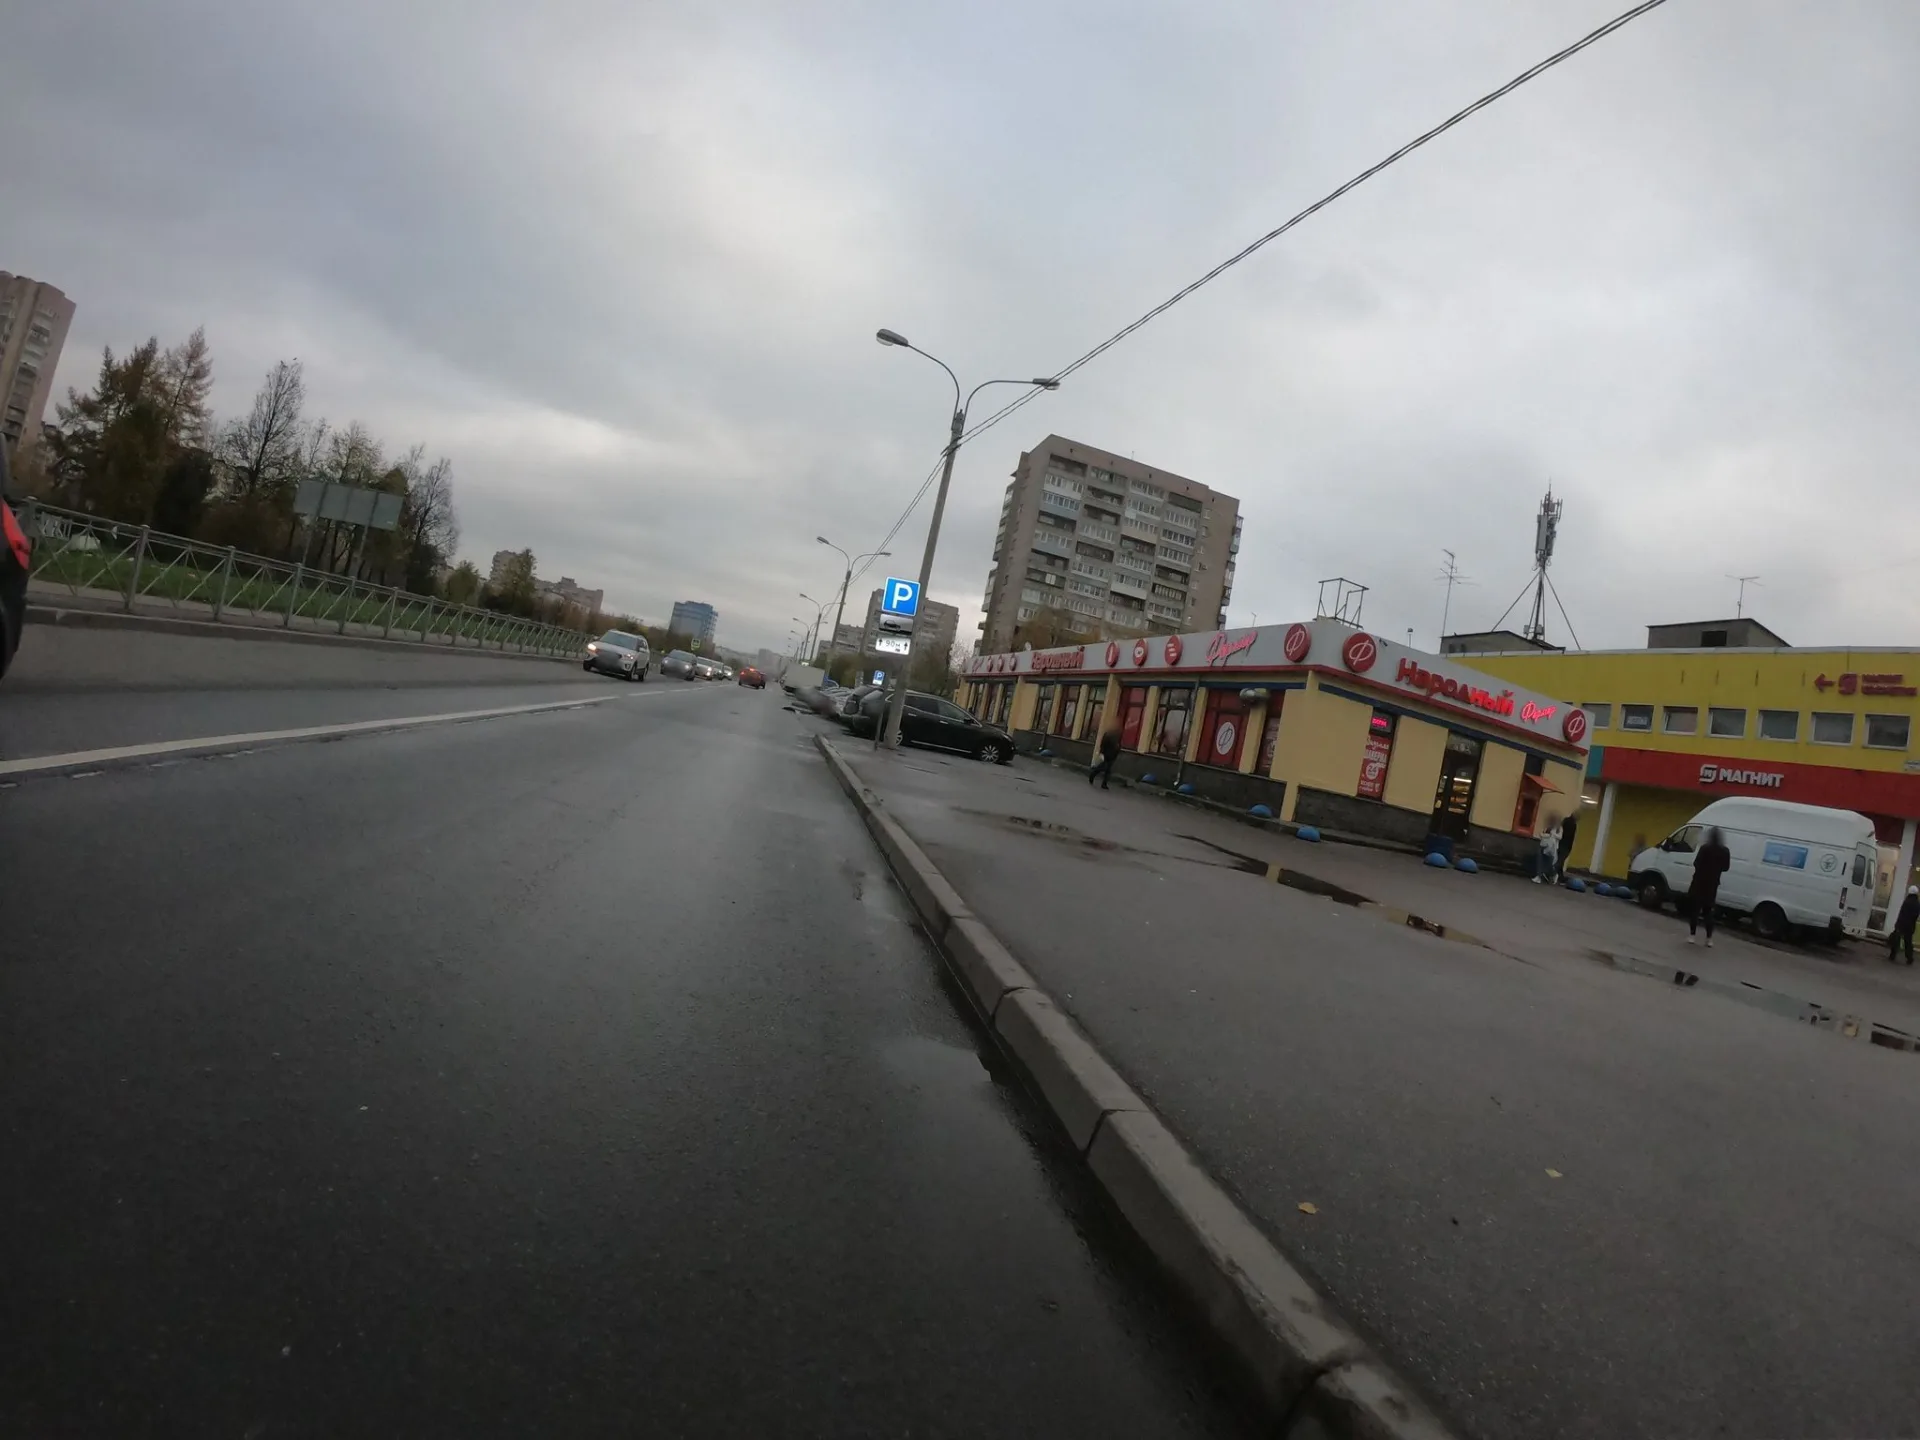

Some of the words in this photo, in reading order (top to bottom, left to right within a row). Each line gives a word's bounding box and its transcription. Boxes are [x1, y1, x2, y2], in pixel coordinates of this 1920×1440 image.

[892, 583, 912, 608] P
[1395, 657, 1515, 718] Народный
[1718, 768, 1785, 788] МАГНИТ
